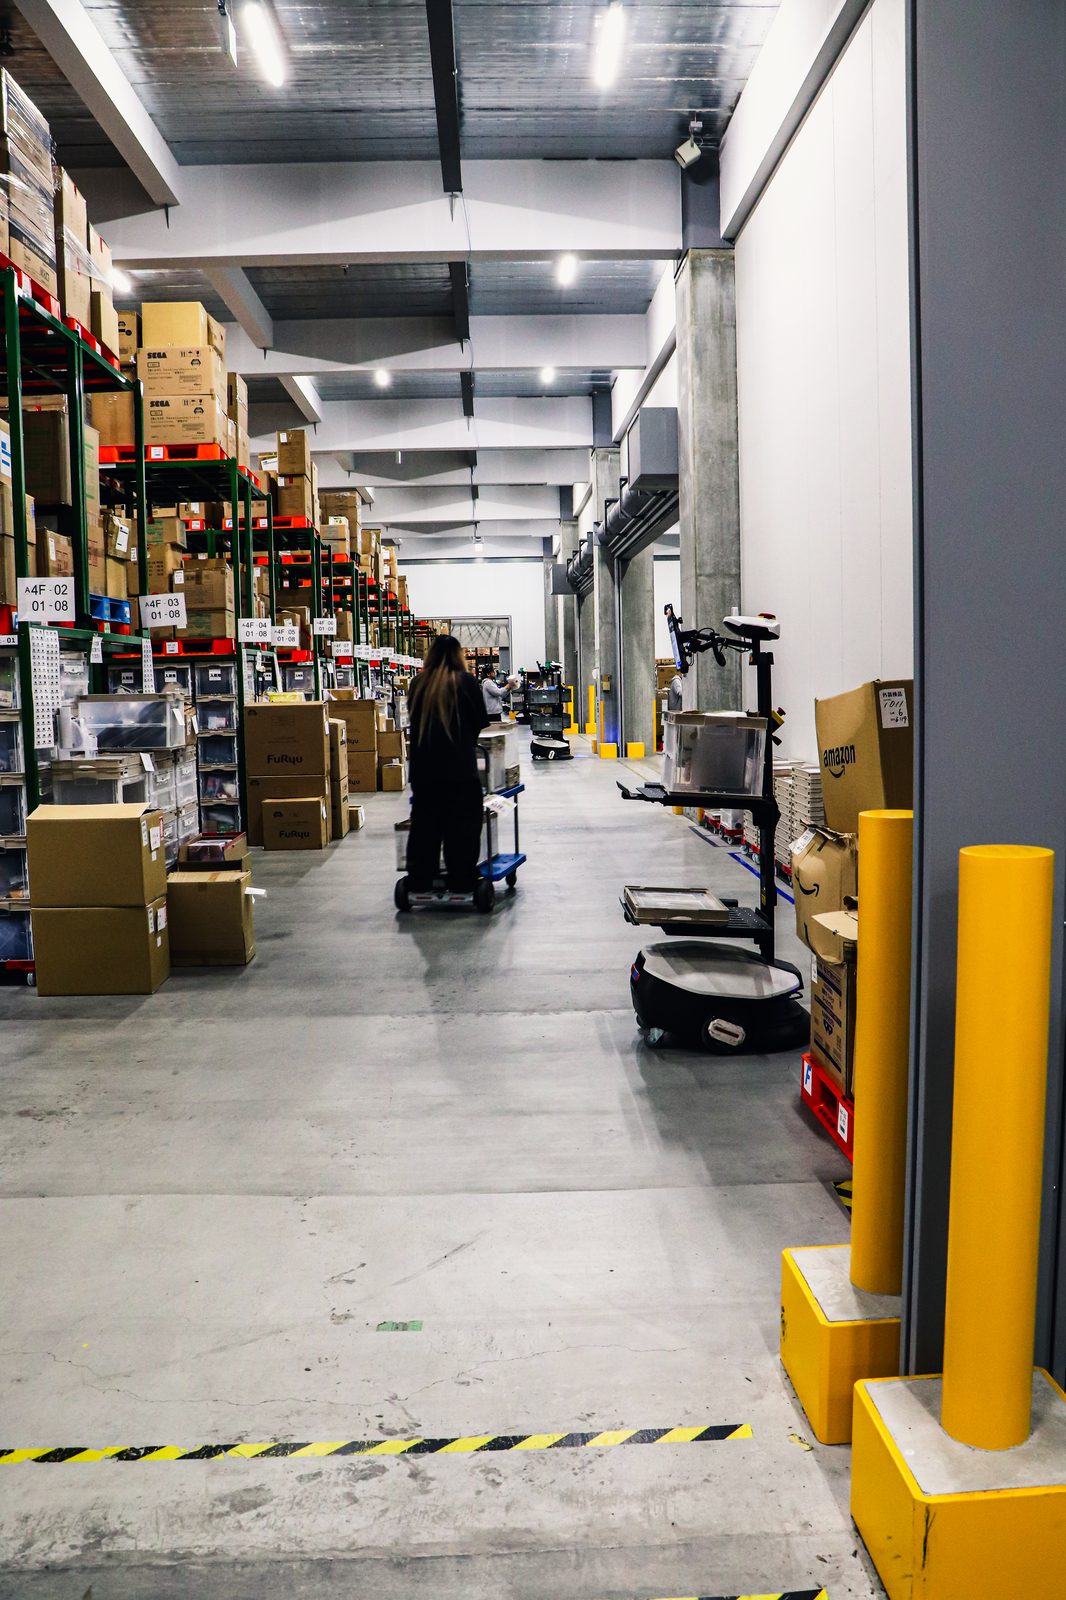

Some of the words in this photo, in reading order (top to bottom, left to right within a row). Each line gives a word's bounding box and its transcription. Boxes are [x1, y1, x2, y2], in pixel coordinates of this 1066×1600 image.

[25, 584, 46, 596] A4F
[54, 584, 68, 595] 02
[32, 600, 45, 612] 01
[55, 600, 68, 611] 08
[145, 600, 161, 608] A4F
[152, 611, 162, 619] 01
[267, 754, 303, 765] FuRyu
[823, 744, 856, 768] amazon
[279, 831, 309, 839] FuRyu
